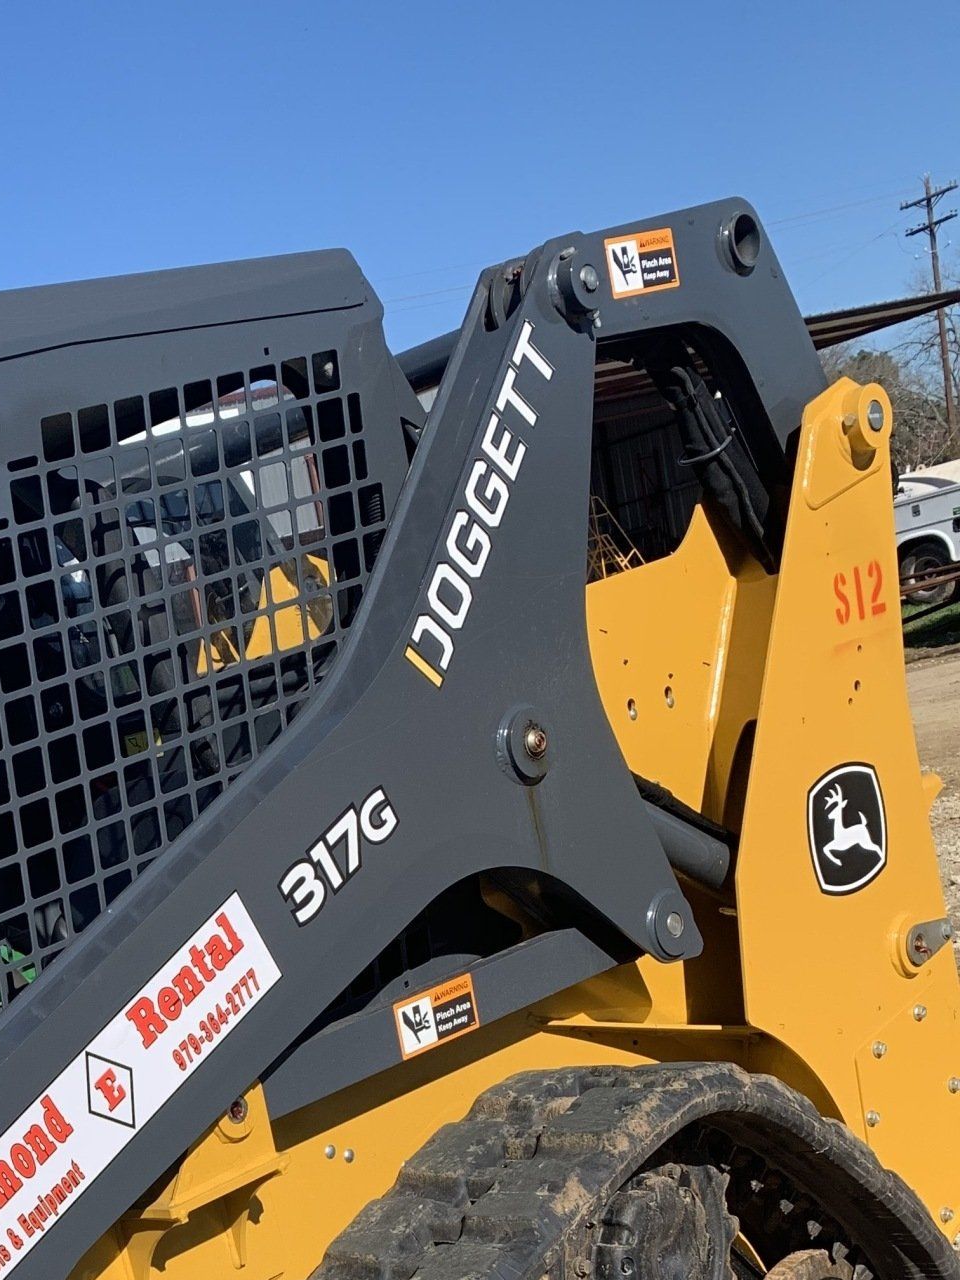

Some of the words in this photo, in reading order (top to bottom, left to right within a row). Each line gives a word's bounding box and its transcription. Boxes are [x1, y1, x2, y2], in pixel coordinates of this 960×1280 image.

[641, 258, 658, 269] Pinch
[658, 256, 672, 265] Area
[656, 269, 670, 278] Away
[404, 319, 556, 688] DOGGETT
[833, 560, 886, 625] S12
[279, 785, 399, 927] 317G
[95, 1068, 126, 1112] E
[126, 912, 244, 1049] Rental
[172, 968, 262, 1072] 979-364-2777
[435, 1007, 455, 1022] Pinch
[455, 1001, 471, 1014] Area
[440, 981, 468, 997] WARNING
[438, 1022, 453, 1032] Keep
[453, 1014, 468, 1026] Away
[9, 1226, 24, 1250] &
[17, 1159, 85, 1232] Equipment
